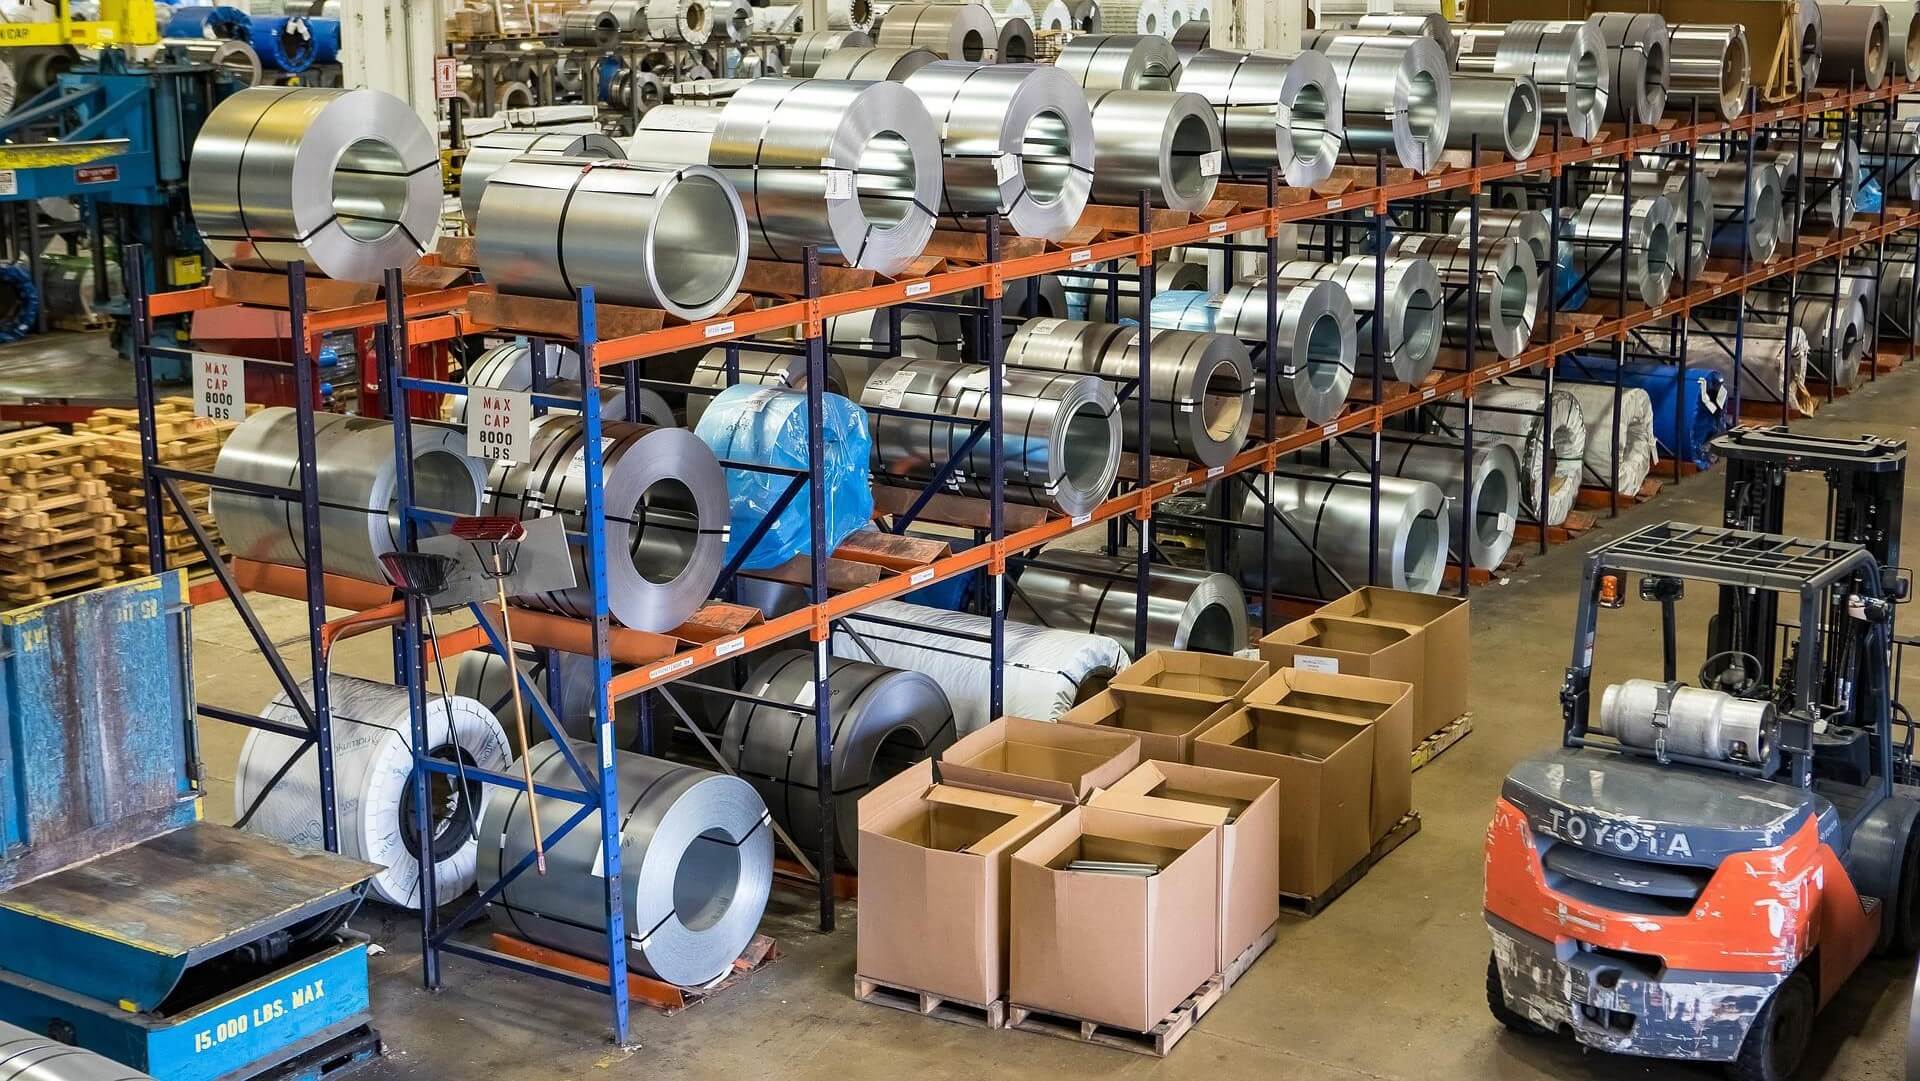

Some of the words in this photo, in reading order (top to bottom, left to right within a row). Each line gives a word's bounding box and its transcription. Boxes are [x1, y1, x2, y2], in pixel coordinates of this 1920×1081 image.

[205, 362, 228, 376] MAX
[207, 378, 228, 391] CAP
[206, 392, 232, 406] 8000
[483, 396, 511, 411] MAX
[207, 406, 229, 419] LBS
[484, 414, 510, 428] CAP
[480, 430, 512, 446] 8000
[483, 445, 510, 460] LBS
[1548, 808, 1692, 858] TOYOTA
[253, 999, 288, 1027] LBS.
[292, 979, 325, 1010] MAX
